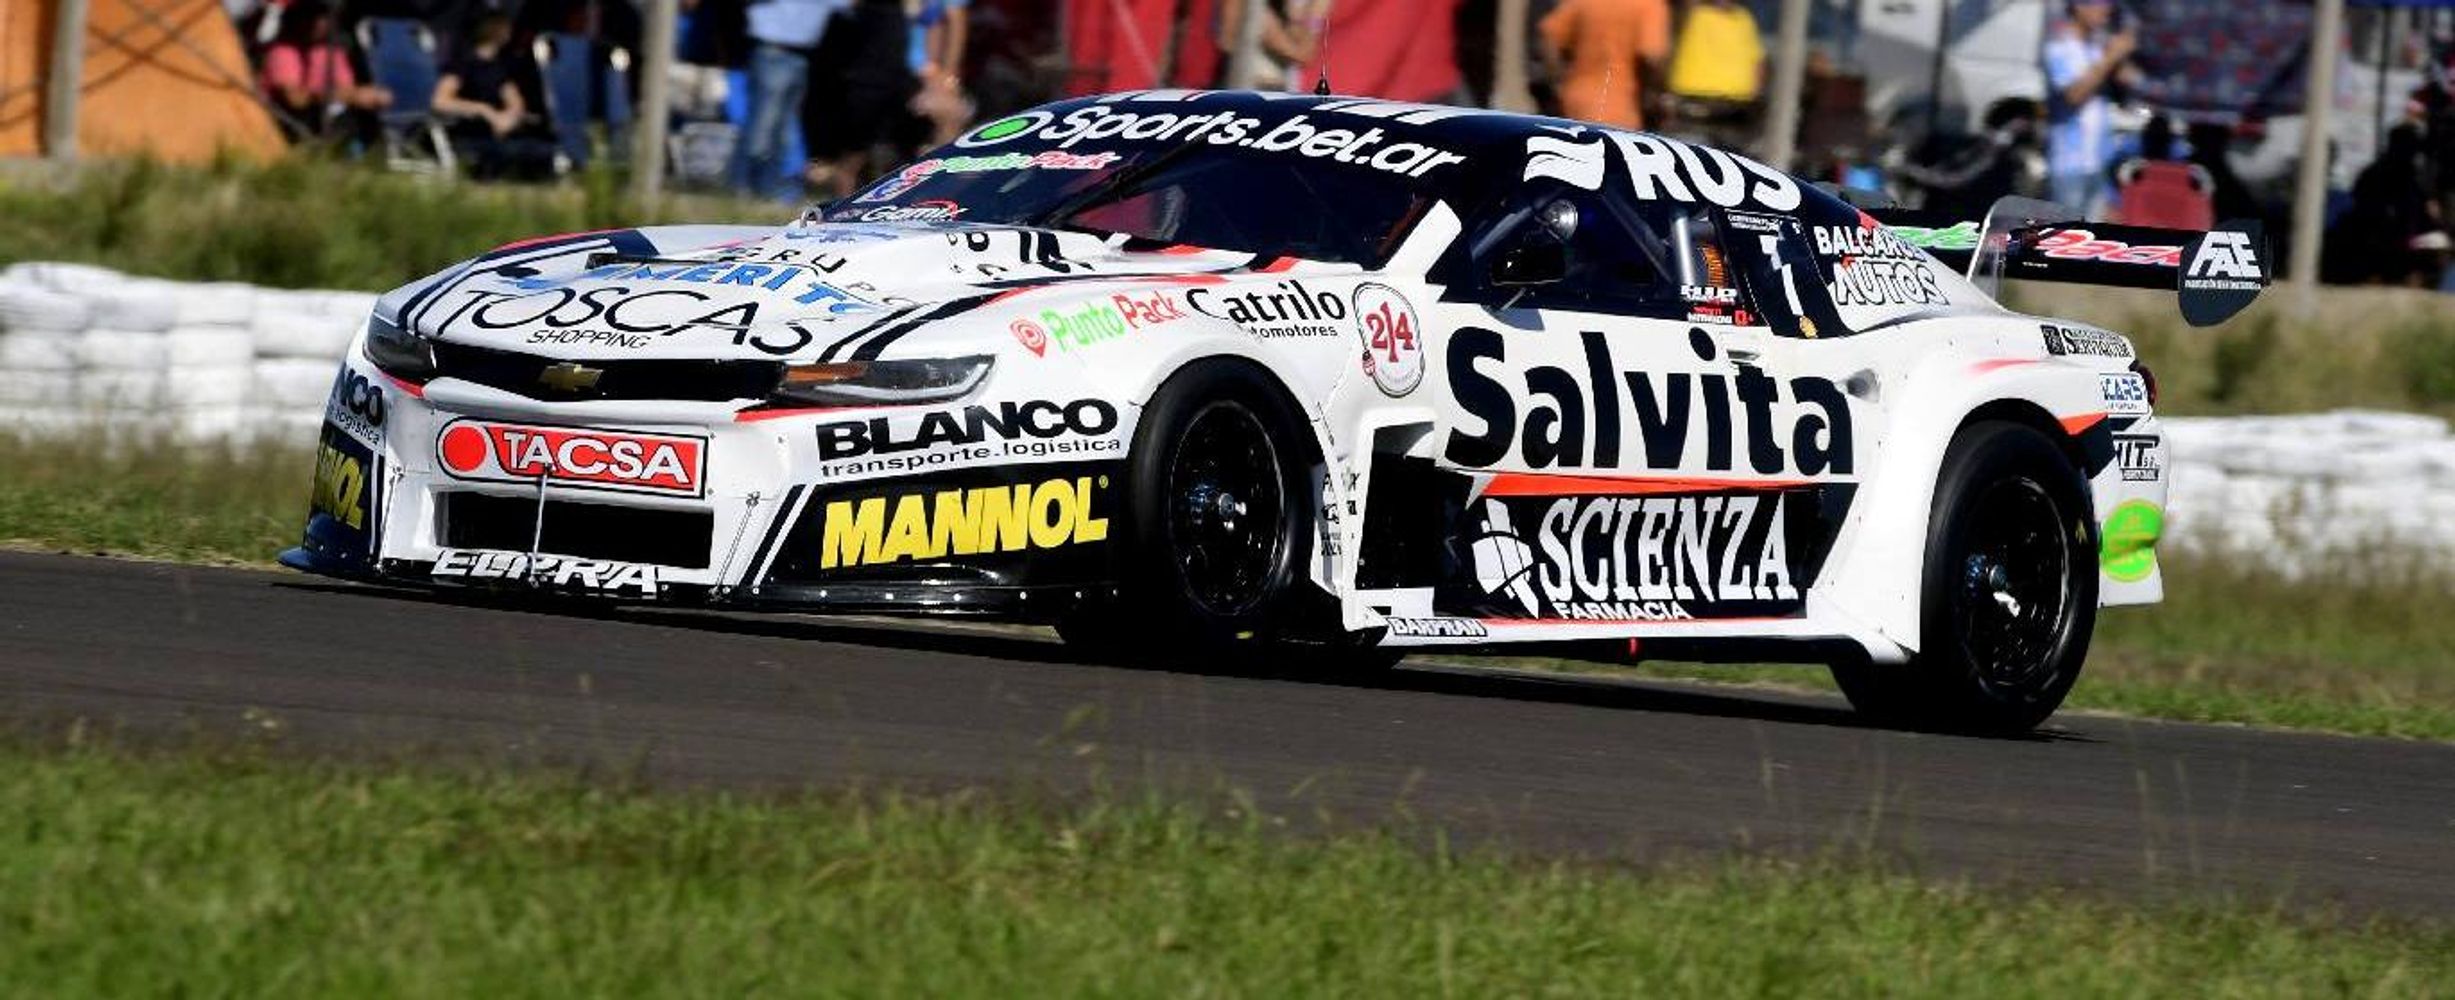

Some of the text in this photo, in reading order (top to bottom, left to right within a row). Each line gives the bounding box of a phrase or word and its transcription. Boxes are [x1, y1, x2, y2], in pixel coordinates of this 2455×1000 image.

[1039, 105, 1467, 178] Sports.bet.ar
[1602, 129, 1801, 211] RUS
[1829, 260, 1950, 305] AUTOS
[438, 286, 813, 355] TOSCAS
[526, 329, 652, 349] SHOPPING
[816, 398, 1119, 462] BLANCO
[1444, 326, 1855, 476] Salvita
[503, 431, 690, 484] TACSA
[821, 477, 1109, 570] MANNOL
[1538, 491, 1799, 604] SCIENZA
[1551, 600, 1696, 620] FARMACIA
